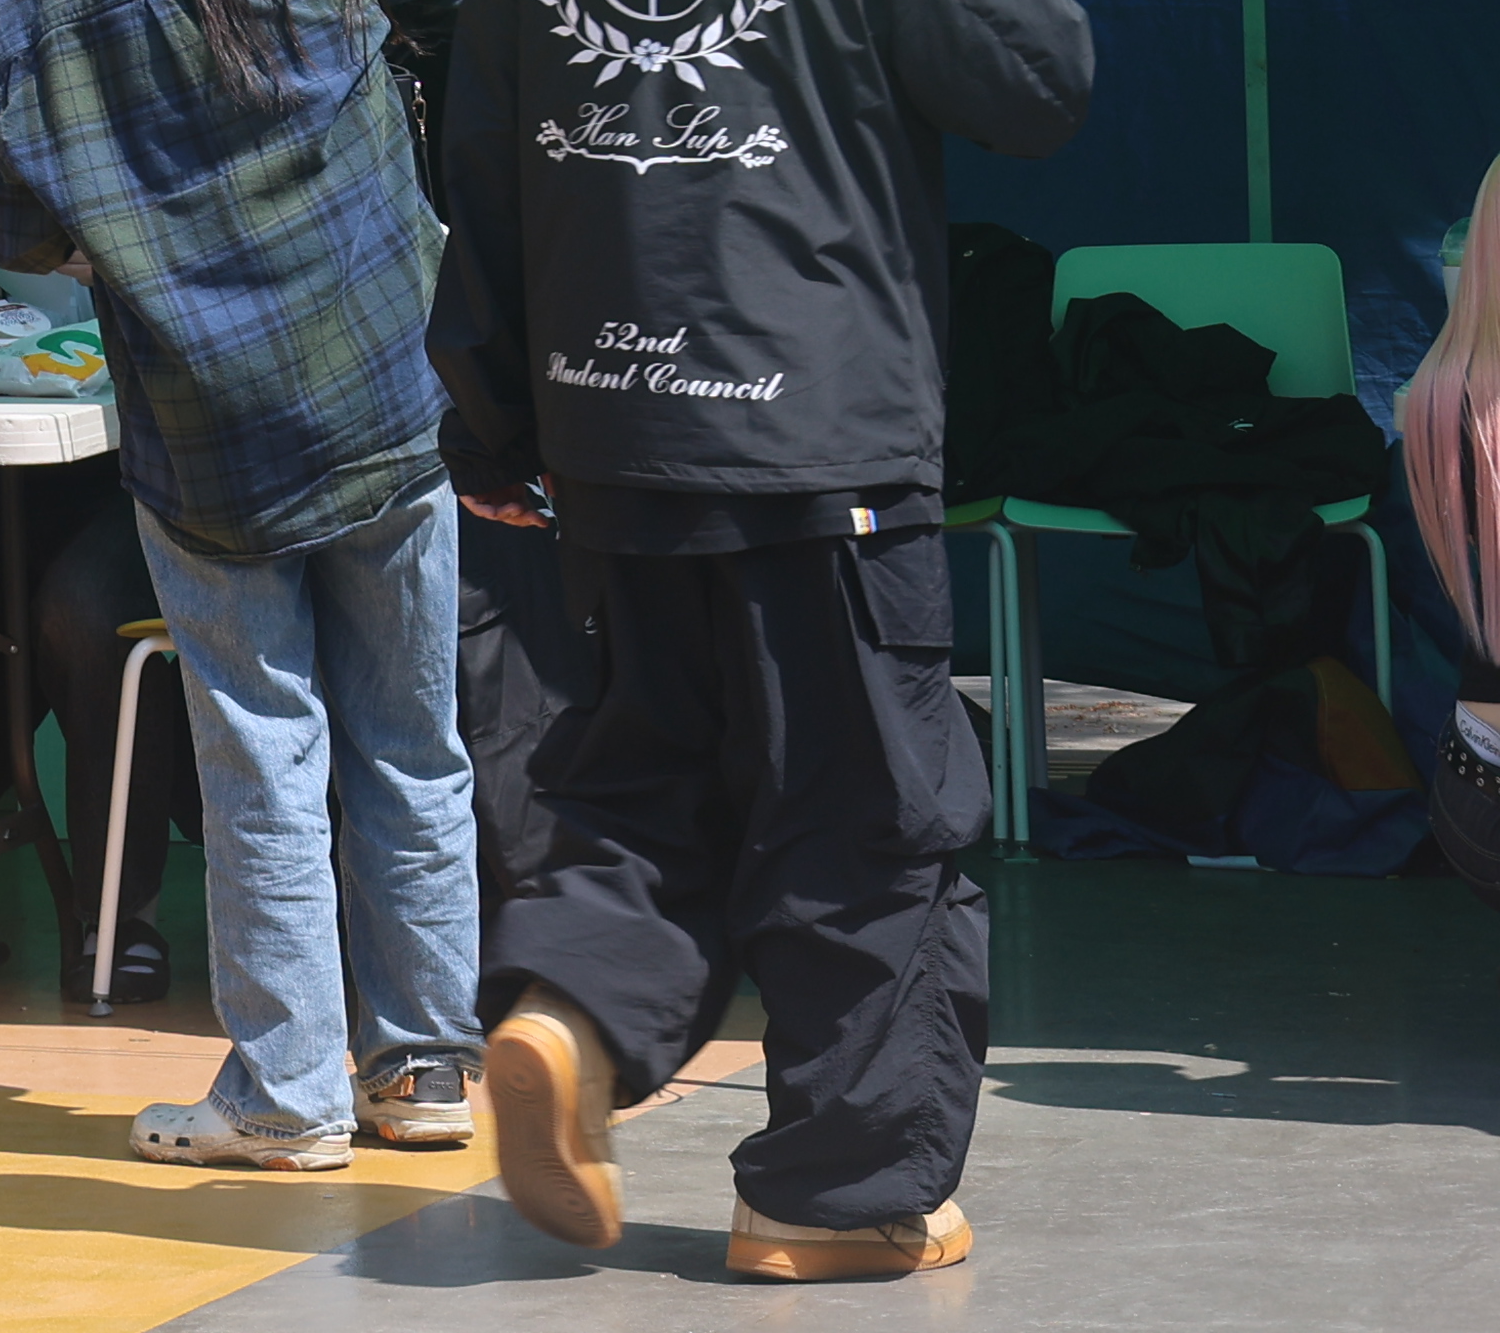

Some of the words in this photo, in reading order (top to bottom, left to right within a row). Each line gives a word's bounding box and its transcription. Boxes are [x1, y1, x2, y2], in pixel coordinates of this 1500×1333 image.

[568, 102, 640, 148] Han
[653, 103, 733, 157] Sup
[594, 320, 689, 356] 52nd
[644, 362, 785, 402] Council
